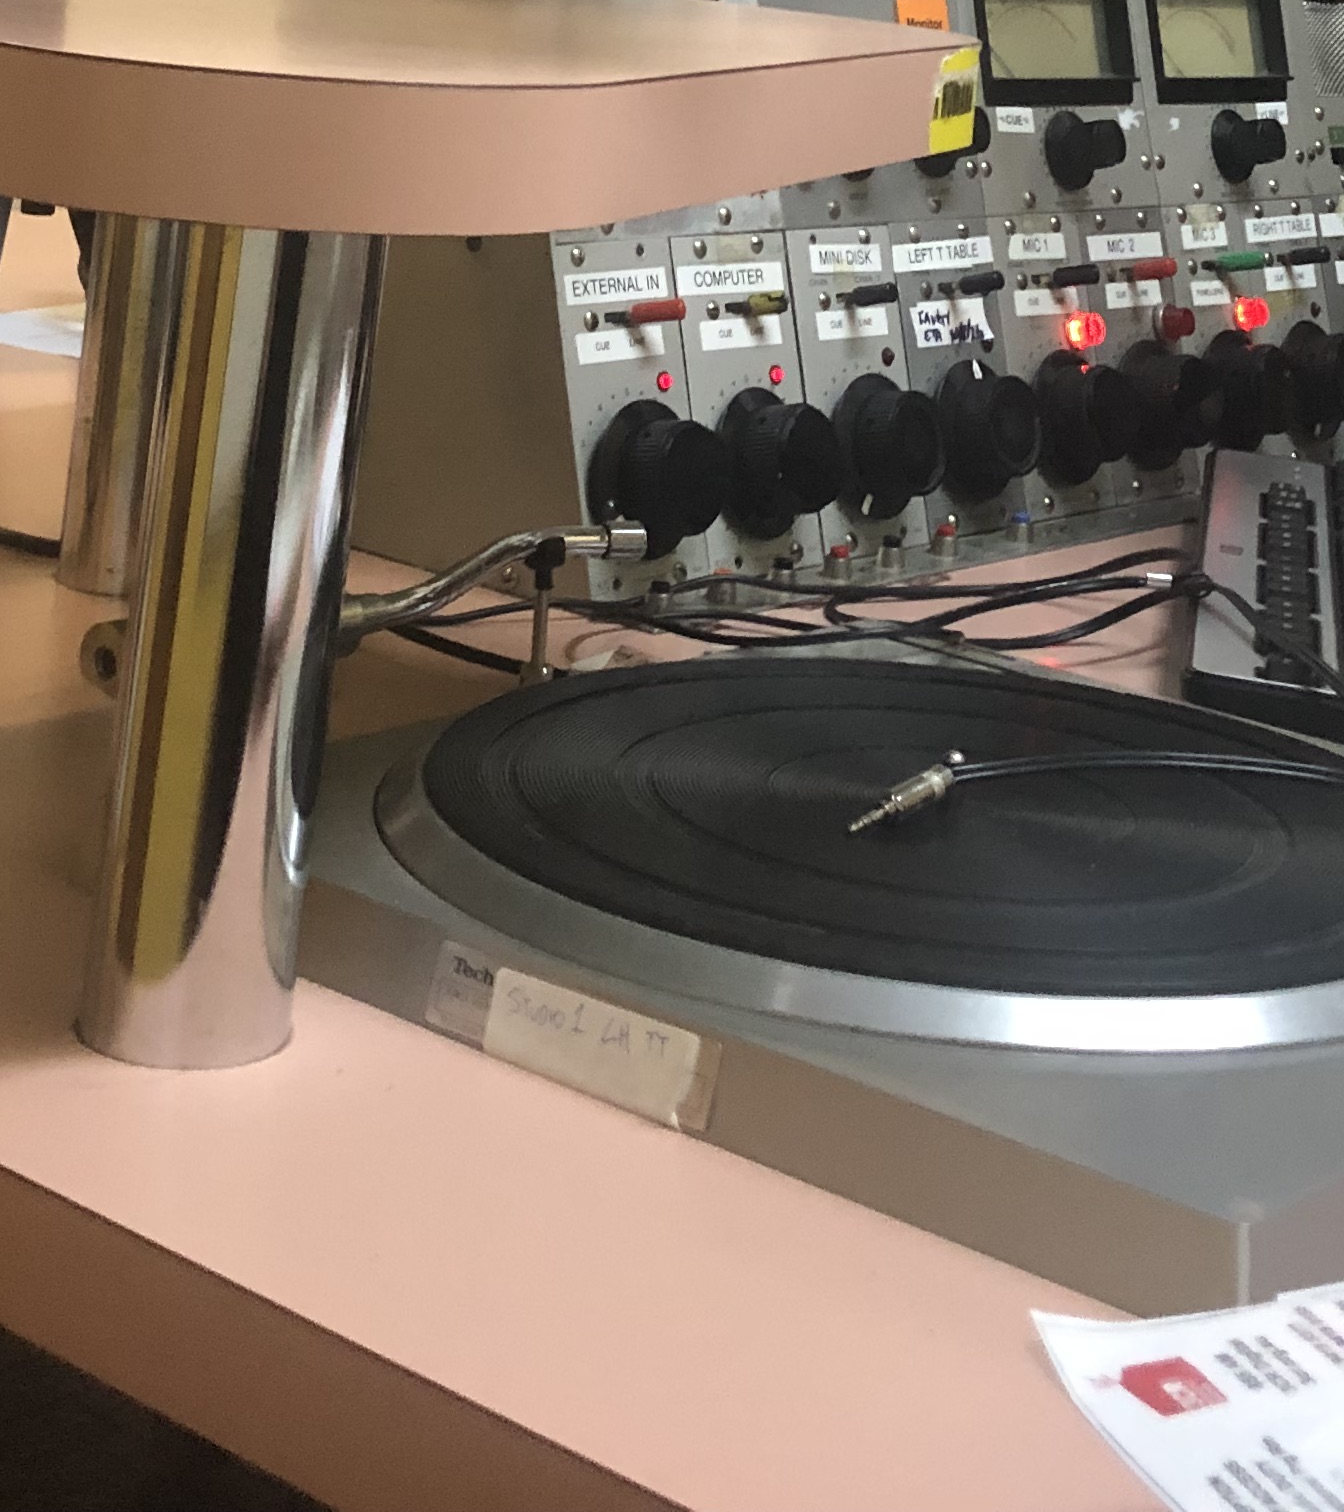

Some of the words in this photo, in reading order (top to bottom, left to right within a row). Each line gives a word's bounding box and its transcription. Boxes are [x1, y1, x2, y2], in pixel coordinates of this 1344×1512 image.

[1253, 222, 1278, 236] RIGHT
[1286, 219, 1312, 234] TABLE
[908, 247, 934, 263] LEFT
[945, 242, 979, 260] TABLE
[1022, 238, 1041, 253] MIC
[1043, 238, 1049, 251] 1
[1107, 239, 1125, 253] MIC
[1128, 238, 1135, 251] 2
[819, 250, 842, 265] MINI
[846, 249, 873, 265] DISK
[572, 276, 644, 297] EXTERNAL
[646, 274, 660, 289] IN
[693, 268, 764, 287] COMPUTER
[595, 340, 611, 351] CUE
[453, 955, 495, 987] Tech
[571, 1002, 584, 1034] 1
